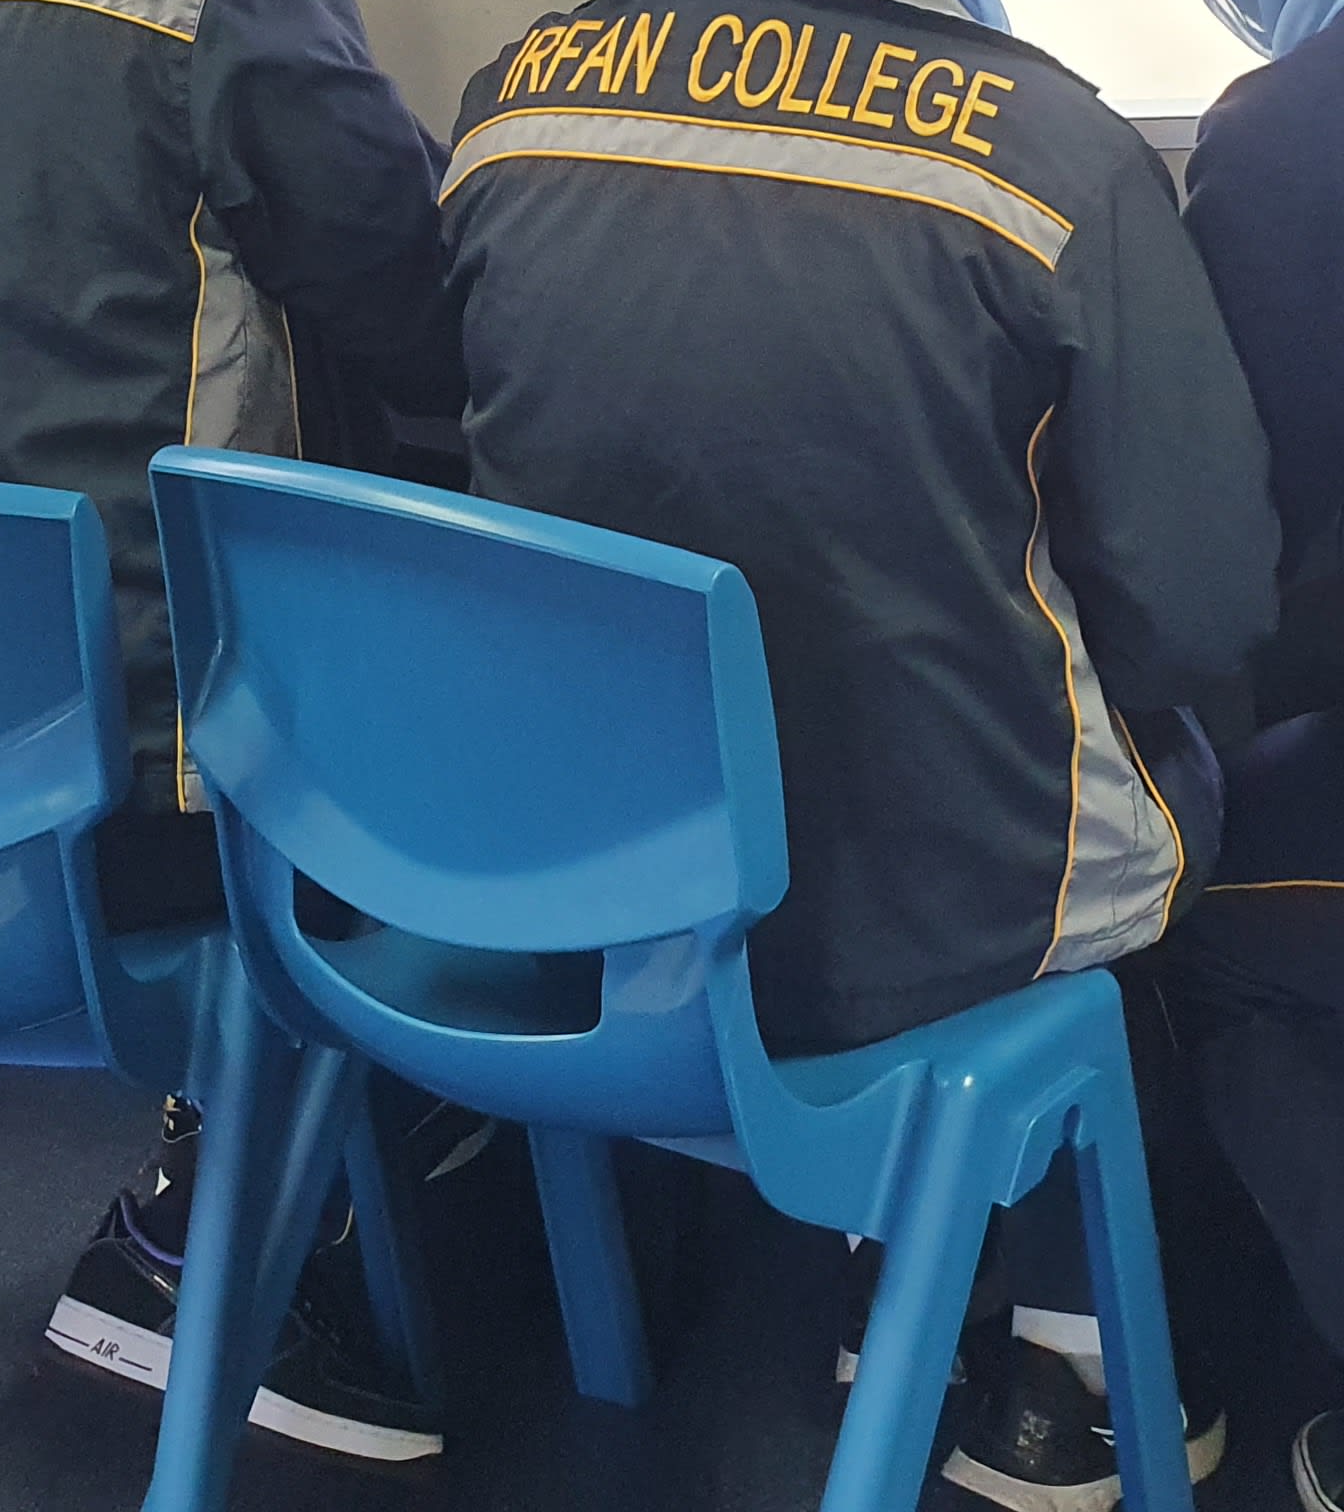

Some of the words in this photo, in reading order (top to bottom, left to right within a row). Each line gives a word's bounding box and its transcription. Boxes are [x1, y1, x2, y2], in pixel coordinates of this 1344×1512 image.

[499, 11, 675, 102] IRFAN
[687, 14, 1014, 156] COLLEGE
[90, 1338, 120, 1361] AIR
